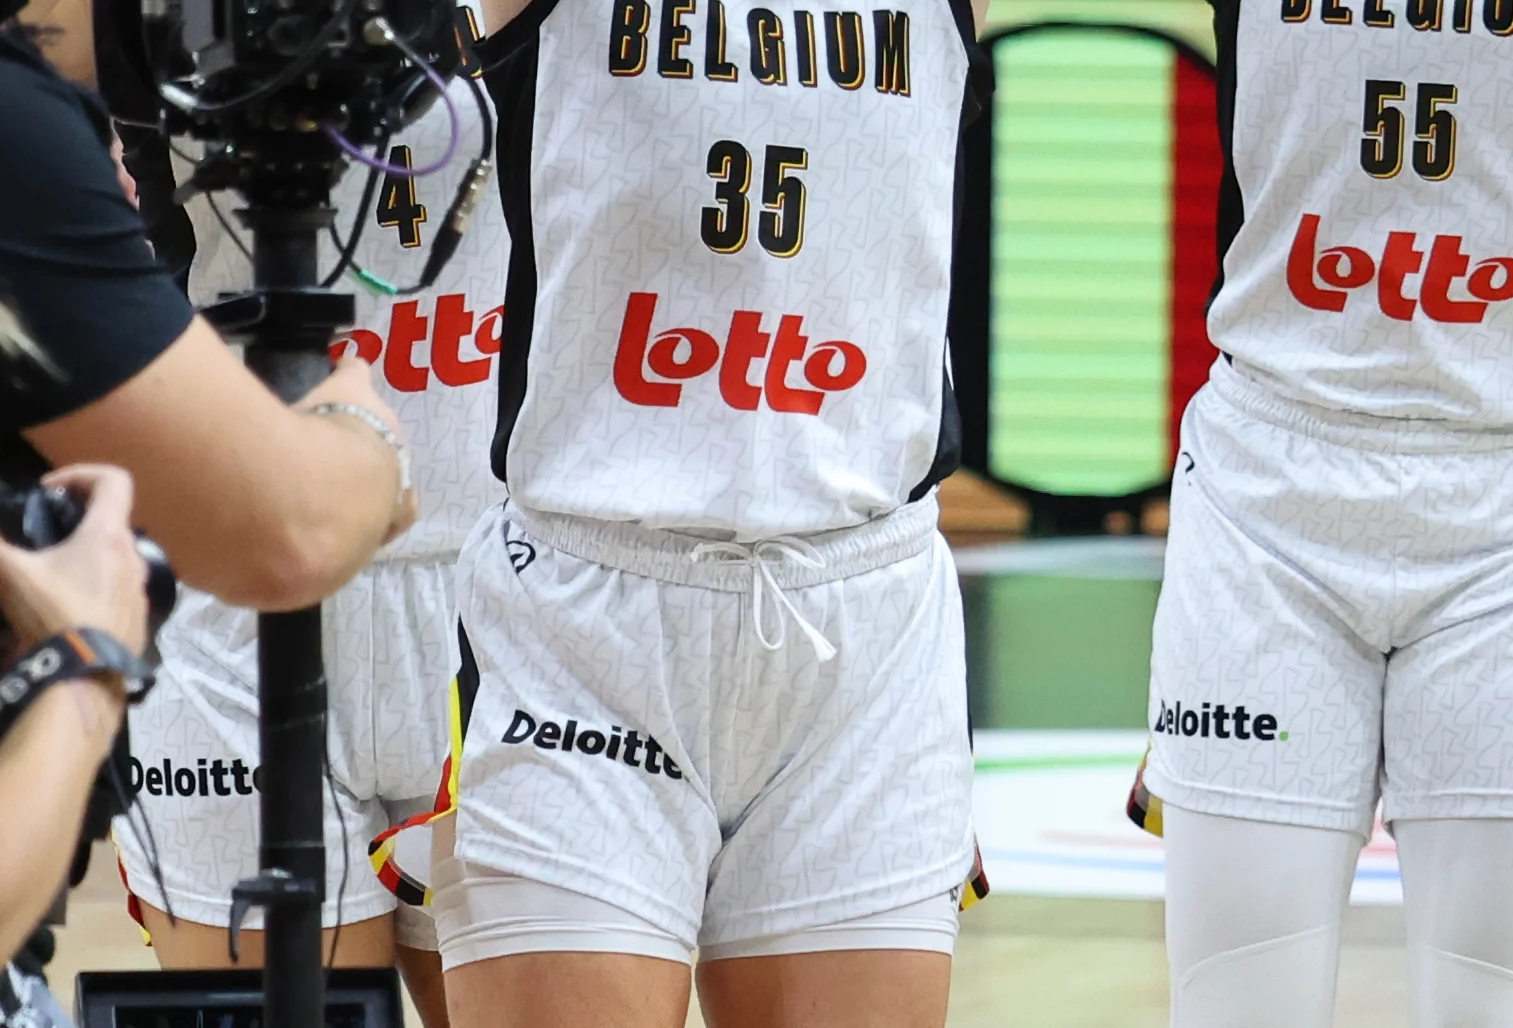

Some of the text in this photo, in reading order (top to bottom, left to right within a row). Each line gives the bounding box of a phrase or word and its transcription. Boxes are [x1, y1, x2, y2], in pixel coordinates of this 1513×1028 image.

[1360, 79, 1457, 181] 55
[377, 145, 427, 248] 4
[700, 139, 808, 259] 35
[613, 292, 867, 416] Lotto
